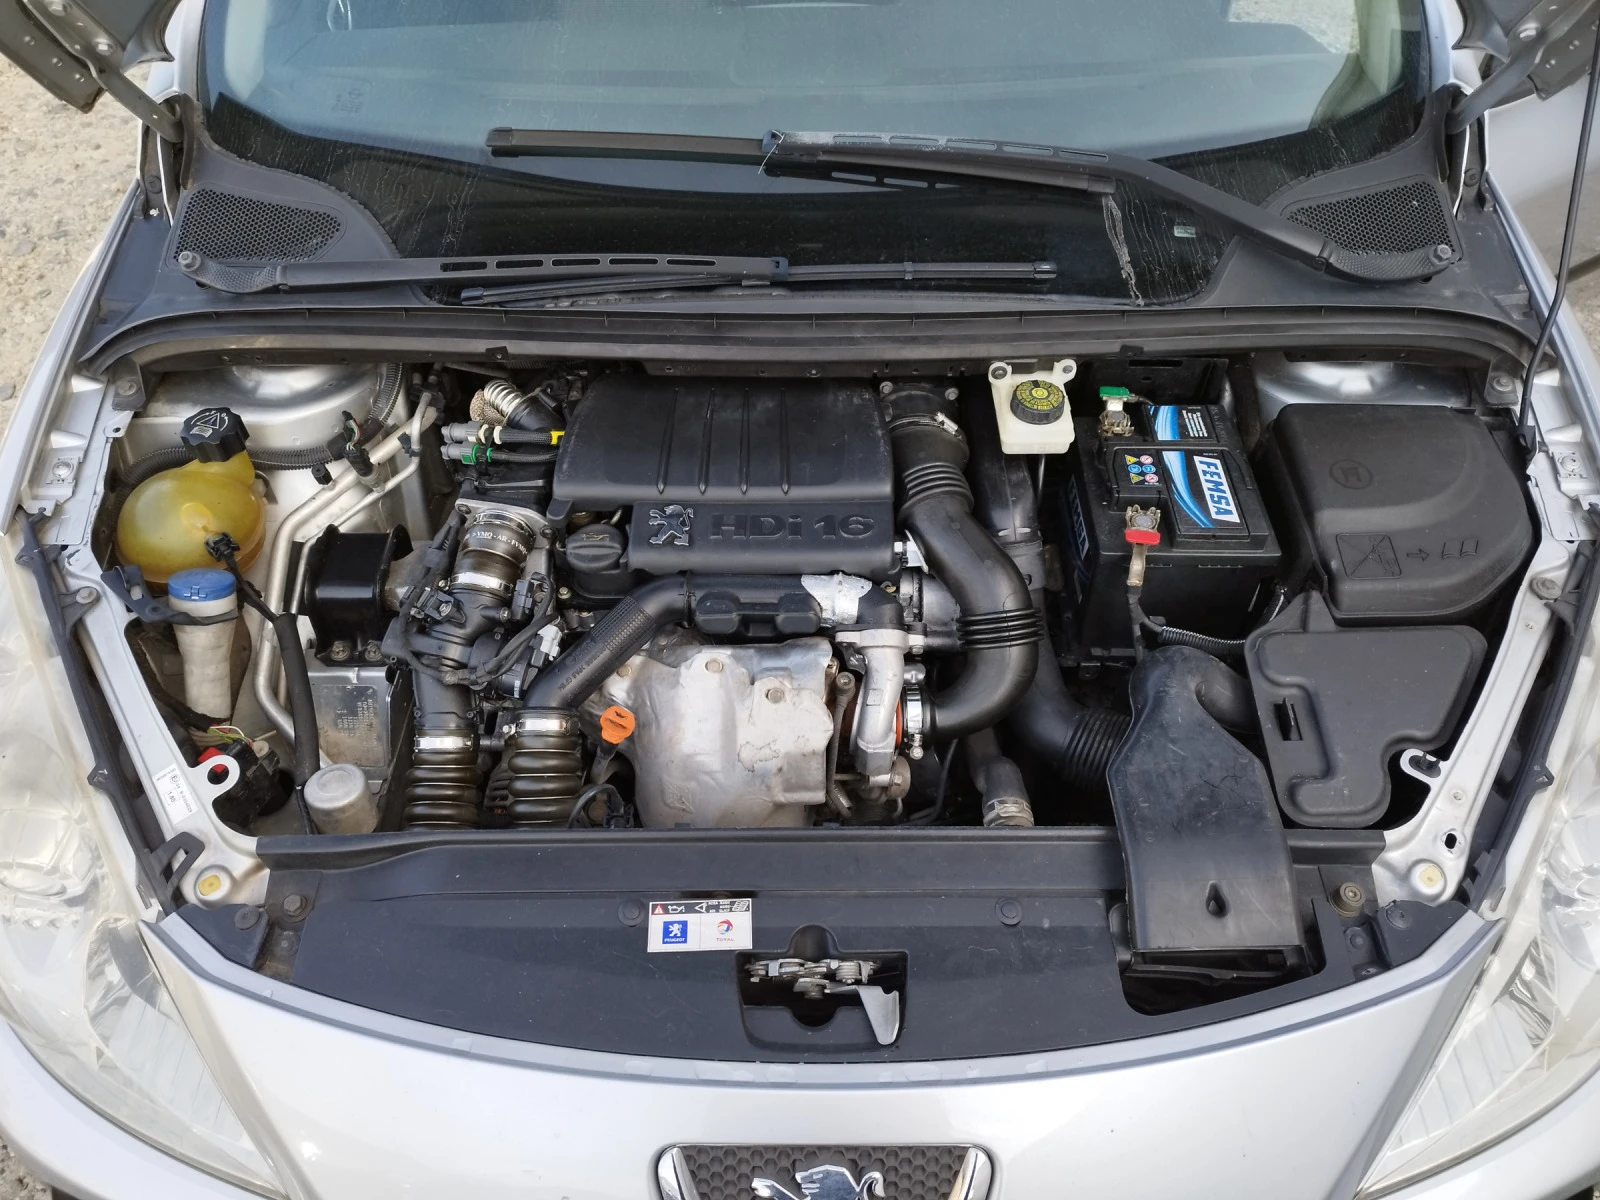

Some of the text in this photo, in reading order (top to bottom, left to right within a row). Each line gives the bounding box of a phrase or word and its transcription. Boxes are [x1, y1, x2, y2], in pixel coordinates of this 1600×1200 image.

[1198, 460, 1234, 516] FEMSA
[709, 513, 875, 540] HDi 16
